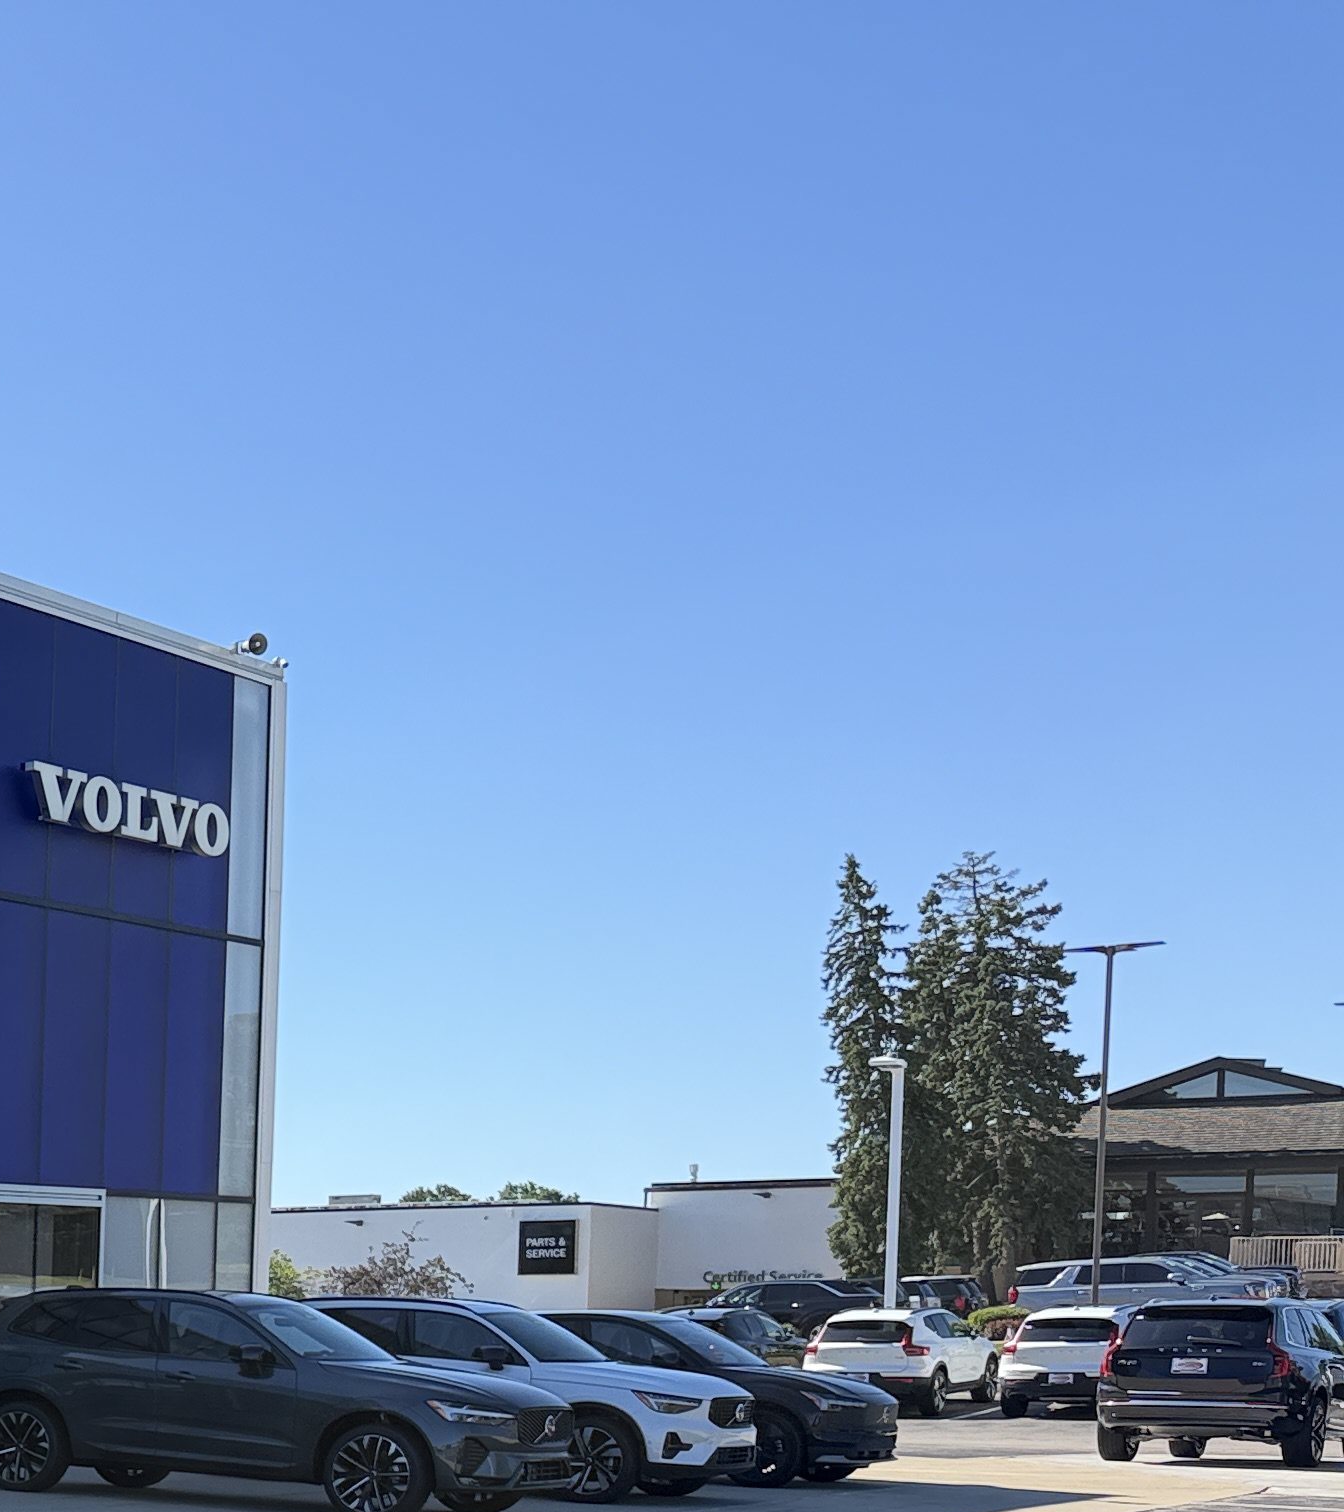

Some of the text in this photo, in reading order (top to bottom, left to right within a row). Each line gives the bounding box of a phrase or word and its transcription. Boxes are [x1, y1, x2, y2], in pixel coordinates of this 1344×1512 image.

[28, 760, 229, 857] VOLVO
[525, 1236, 566, 1247] PARTS &
[525, 1248, 567, 1259] SERVICE
[702, 1269, 766, 1283] Certified
